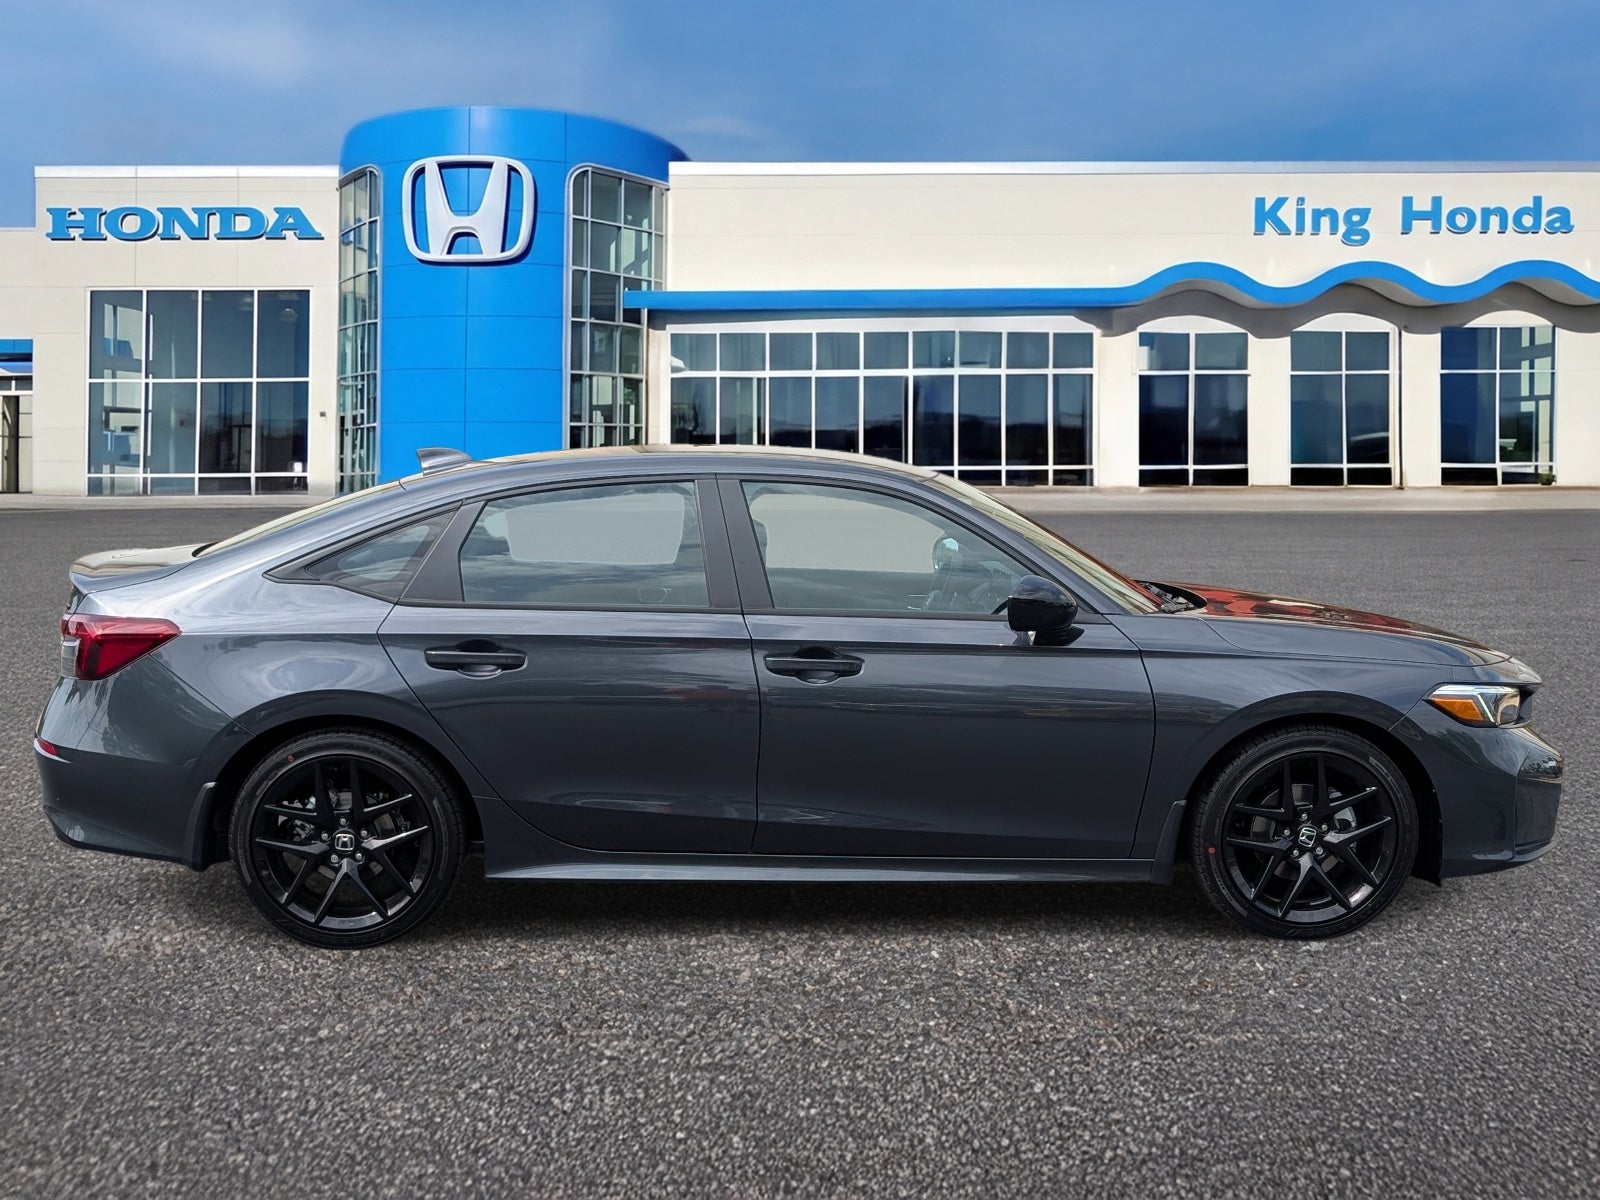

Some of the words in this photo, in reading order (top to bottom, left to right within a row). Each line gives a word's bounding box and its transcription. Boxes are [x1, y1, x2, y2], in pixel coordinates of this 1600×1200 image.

[45, 207, 324, 241] HONDA
[1254, 196, 1371, 246] King
[1401, 196, 1574, 235] Honda
